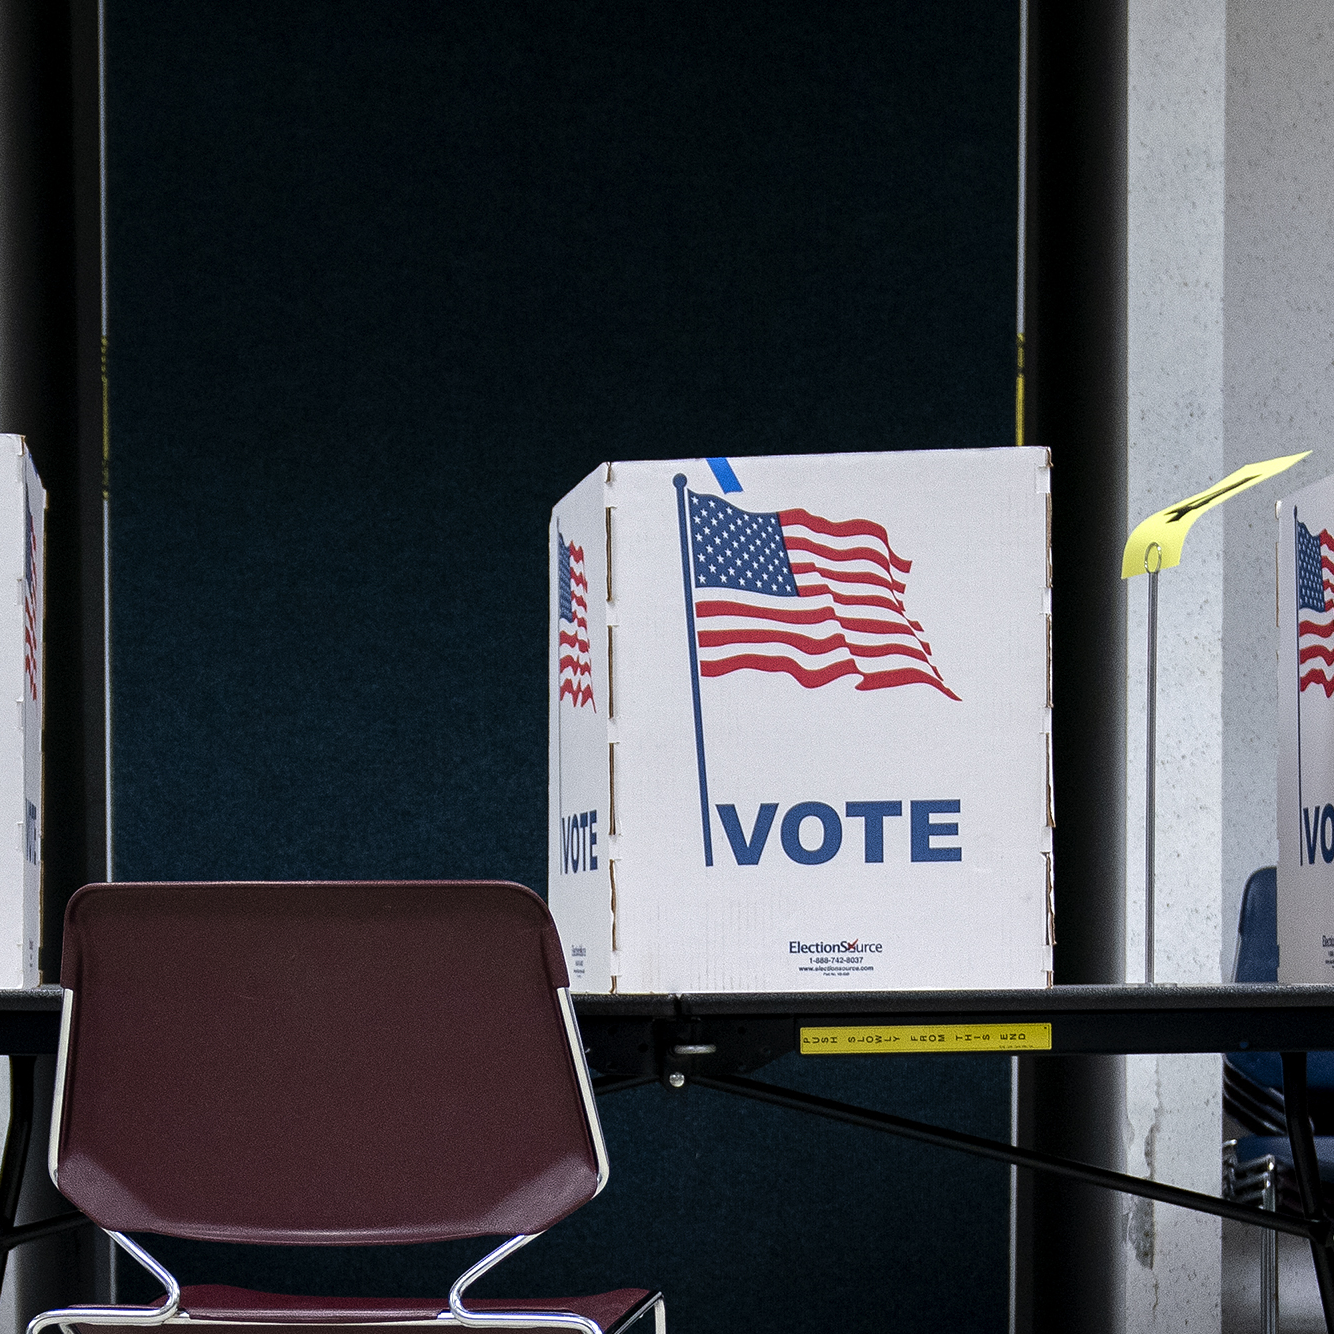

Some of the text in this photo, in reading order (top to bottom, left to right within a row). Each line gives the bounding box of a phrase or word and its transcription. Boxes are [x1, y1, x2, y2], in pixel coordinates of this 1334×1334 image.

[561, 809, 598, 875] VOTE
[715, 799, 963, 867] VOTE
[803, 1032, 1027, 1045] PUSH SLOWLY FROM THIS END
